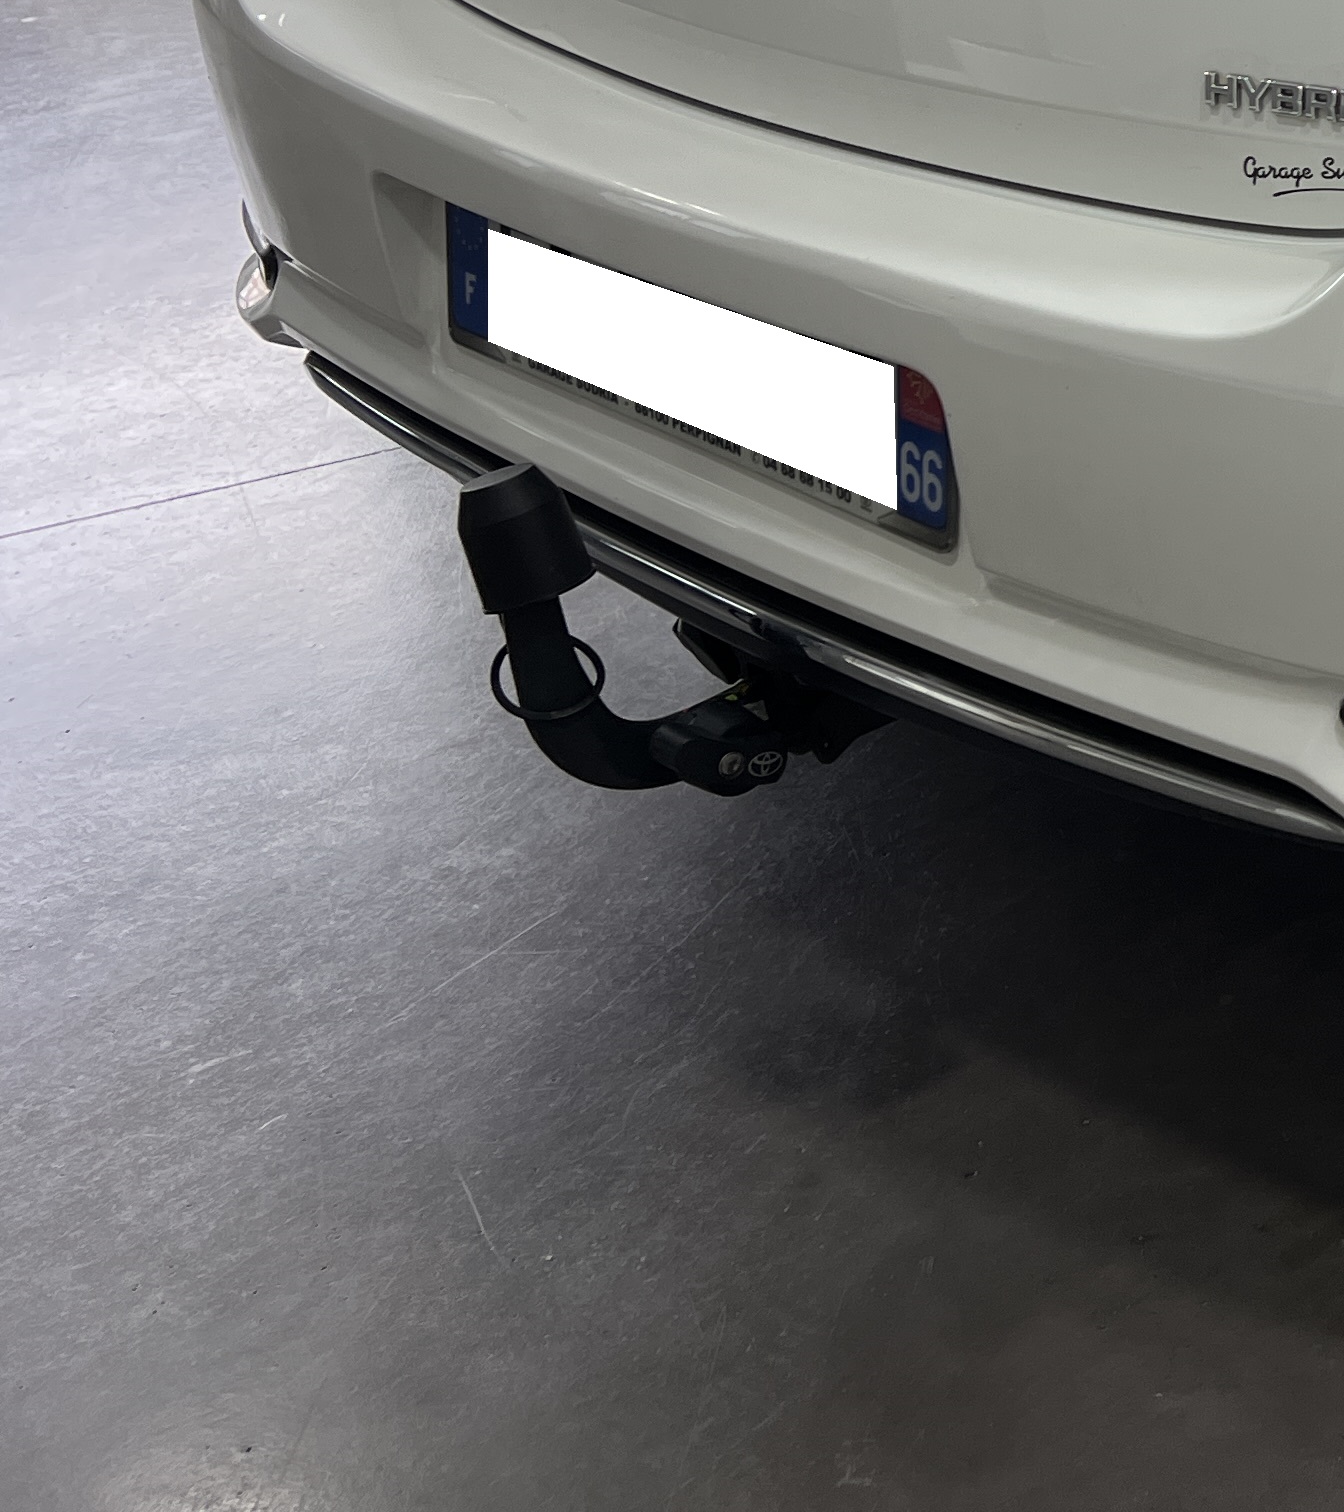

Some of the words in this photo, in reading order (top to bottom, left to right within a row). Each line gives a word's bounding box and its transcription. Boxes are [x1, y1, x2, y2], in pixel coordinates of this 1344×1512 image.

[1243, 155, 1314, 187] Garage
[464, 271, 478, 306] F
[900, 440, 944, 513] 66
